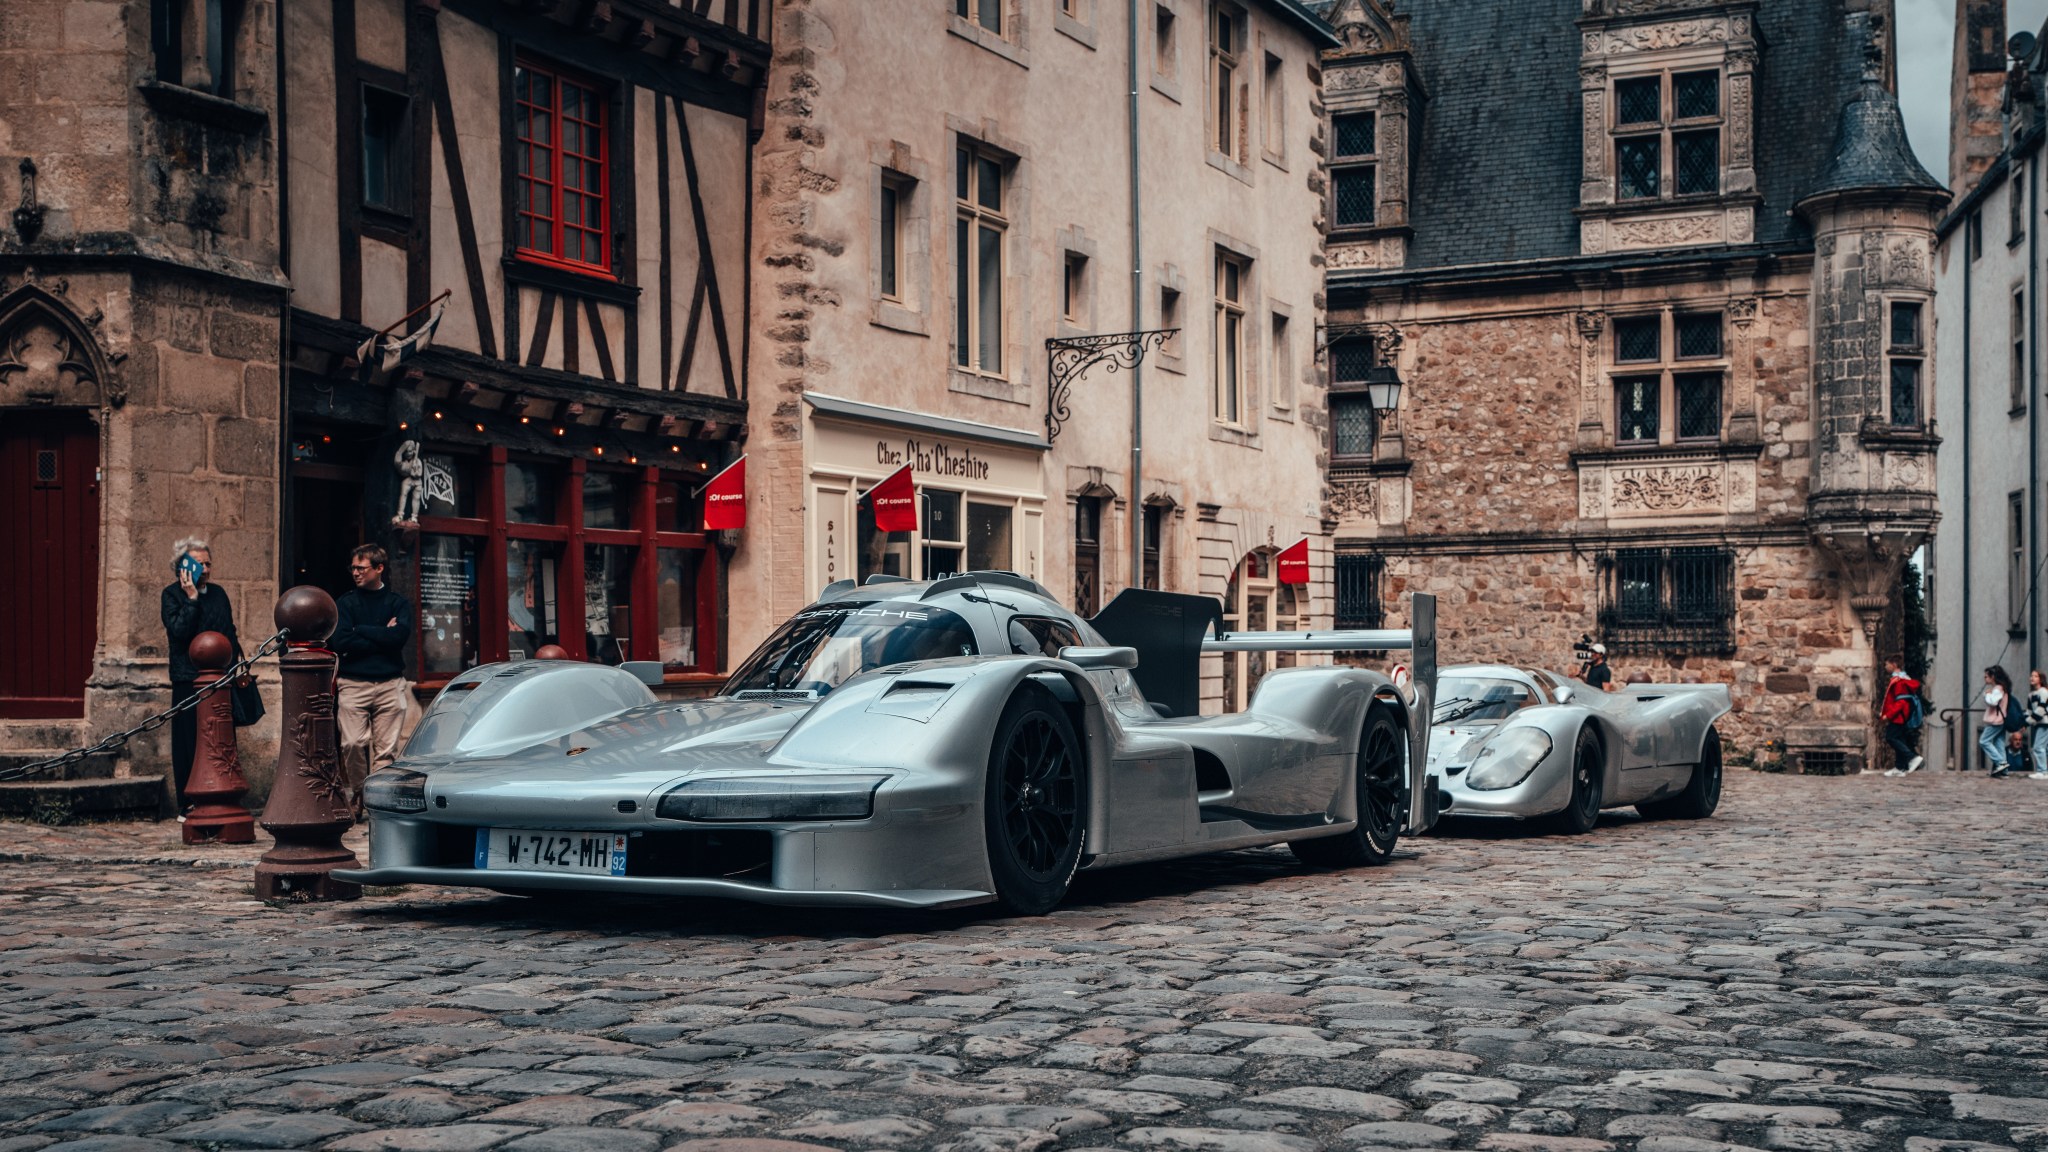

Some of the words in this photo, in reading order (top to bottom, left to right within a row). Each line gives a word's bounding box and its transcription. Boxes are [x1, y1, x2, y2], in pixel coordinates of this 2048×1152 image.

[877, 440, 902, 466] Chez
[720, 493, 743, 501] course
[933, 510, 942, 521] 10
[827, 520, 835, 584] SALON
[479, 852, 485, 860] F
[613, 856, 625, 871] 92
